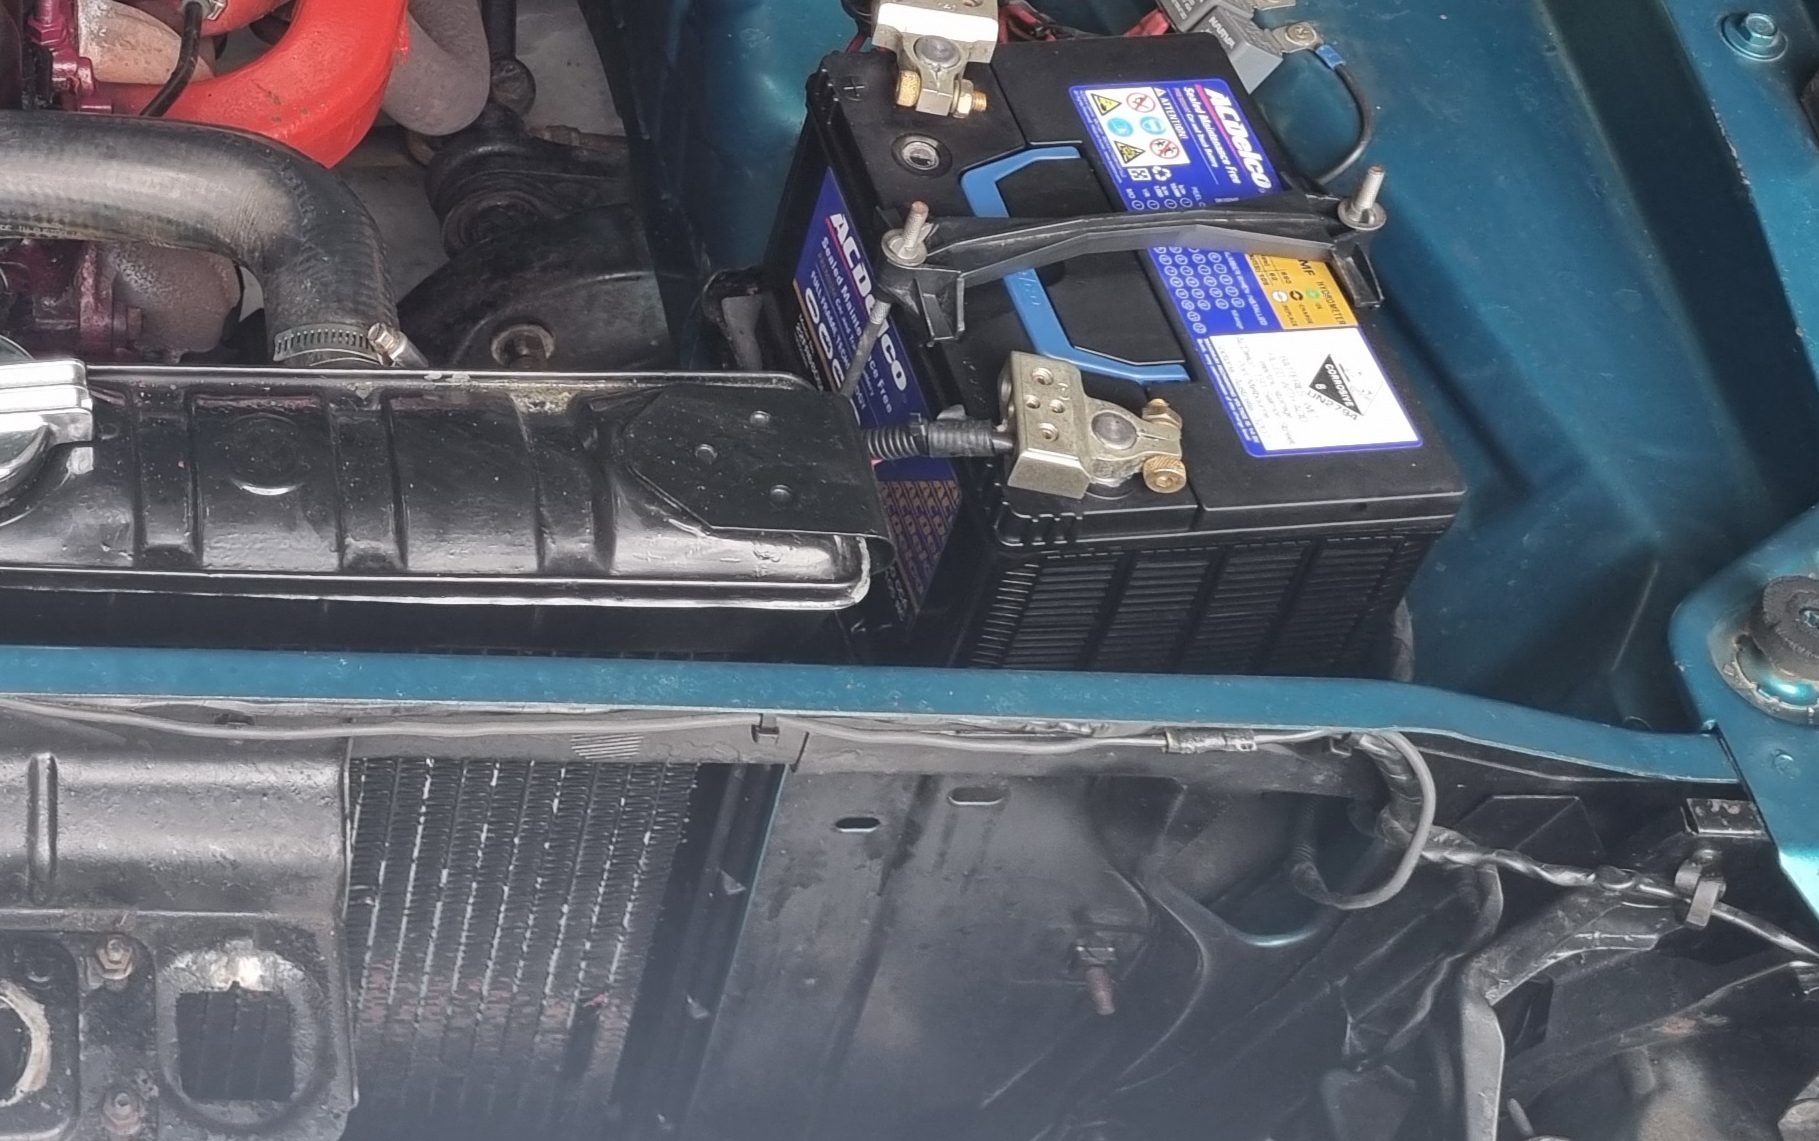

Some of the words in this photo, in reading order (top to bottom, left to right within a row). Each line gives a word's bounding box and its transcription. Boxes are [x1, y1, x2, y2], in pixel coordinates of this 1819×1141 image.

[1208, 16, 1236, 49] NARVA
[1157, 96, 1190, 140] ATTENTION!
[1181, 86, 1207, 114] Sealed
[1196, 114, 1234, 165] Maintenance
[1223, 165, 1245, 184] Free
[1204, 87, 1272, 189] ACDelco
[806, 268, 826, 301] FULL
[832, 295, 846, 315] Car
[1279, 304, 1299, 326] REPLACE
[1296, 303, 1315, 325] CHARGE
[1313, 280, 1348, 325] HYDROMETER
[817, 232, 847, 288] Sealed
[871, 379, 900, 413] Free
[838, 313, 854, 335] and
[1322, 363, 1356, 407] CORROSIVE
[1306, 390, 1359, 421] UN2794
